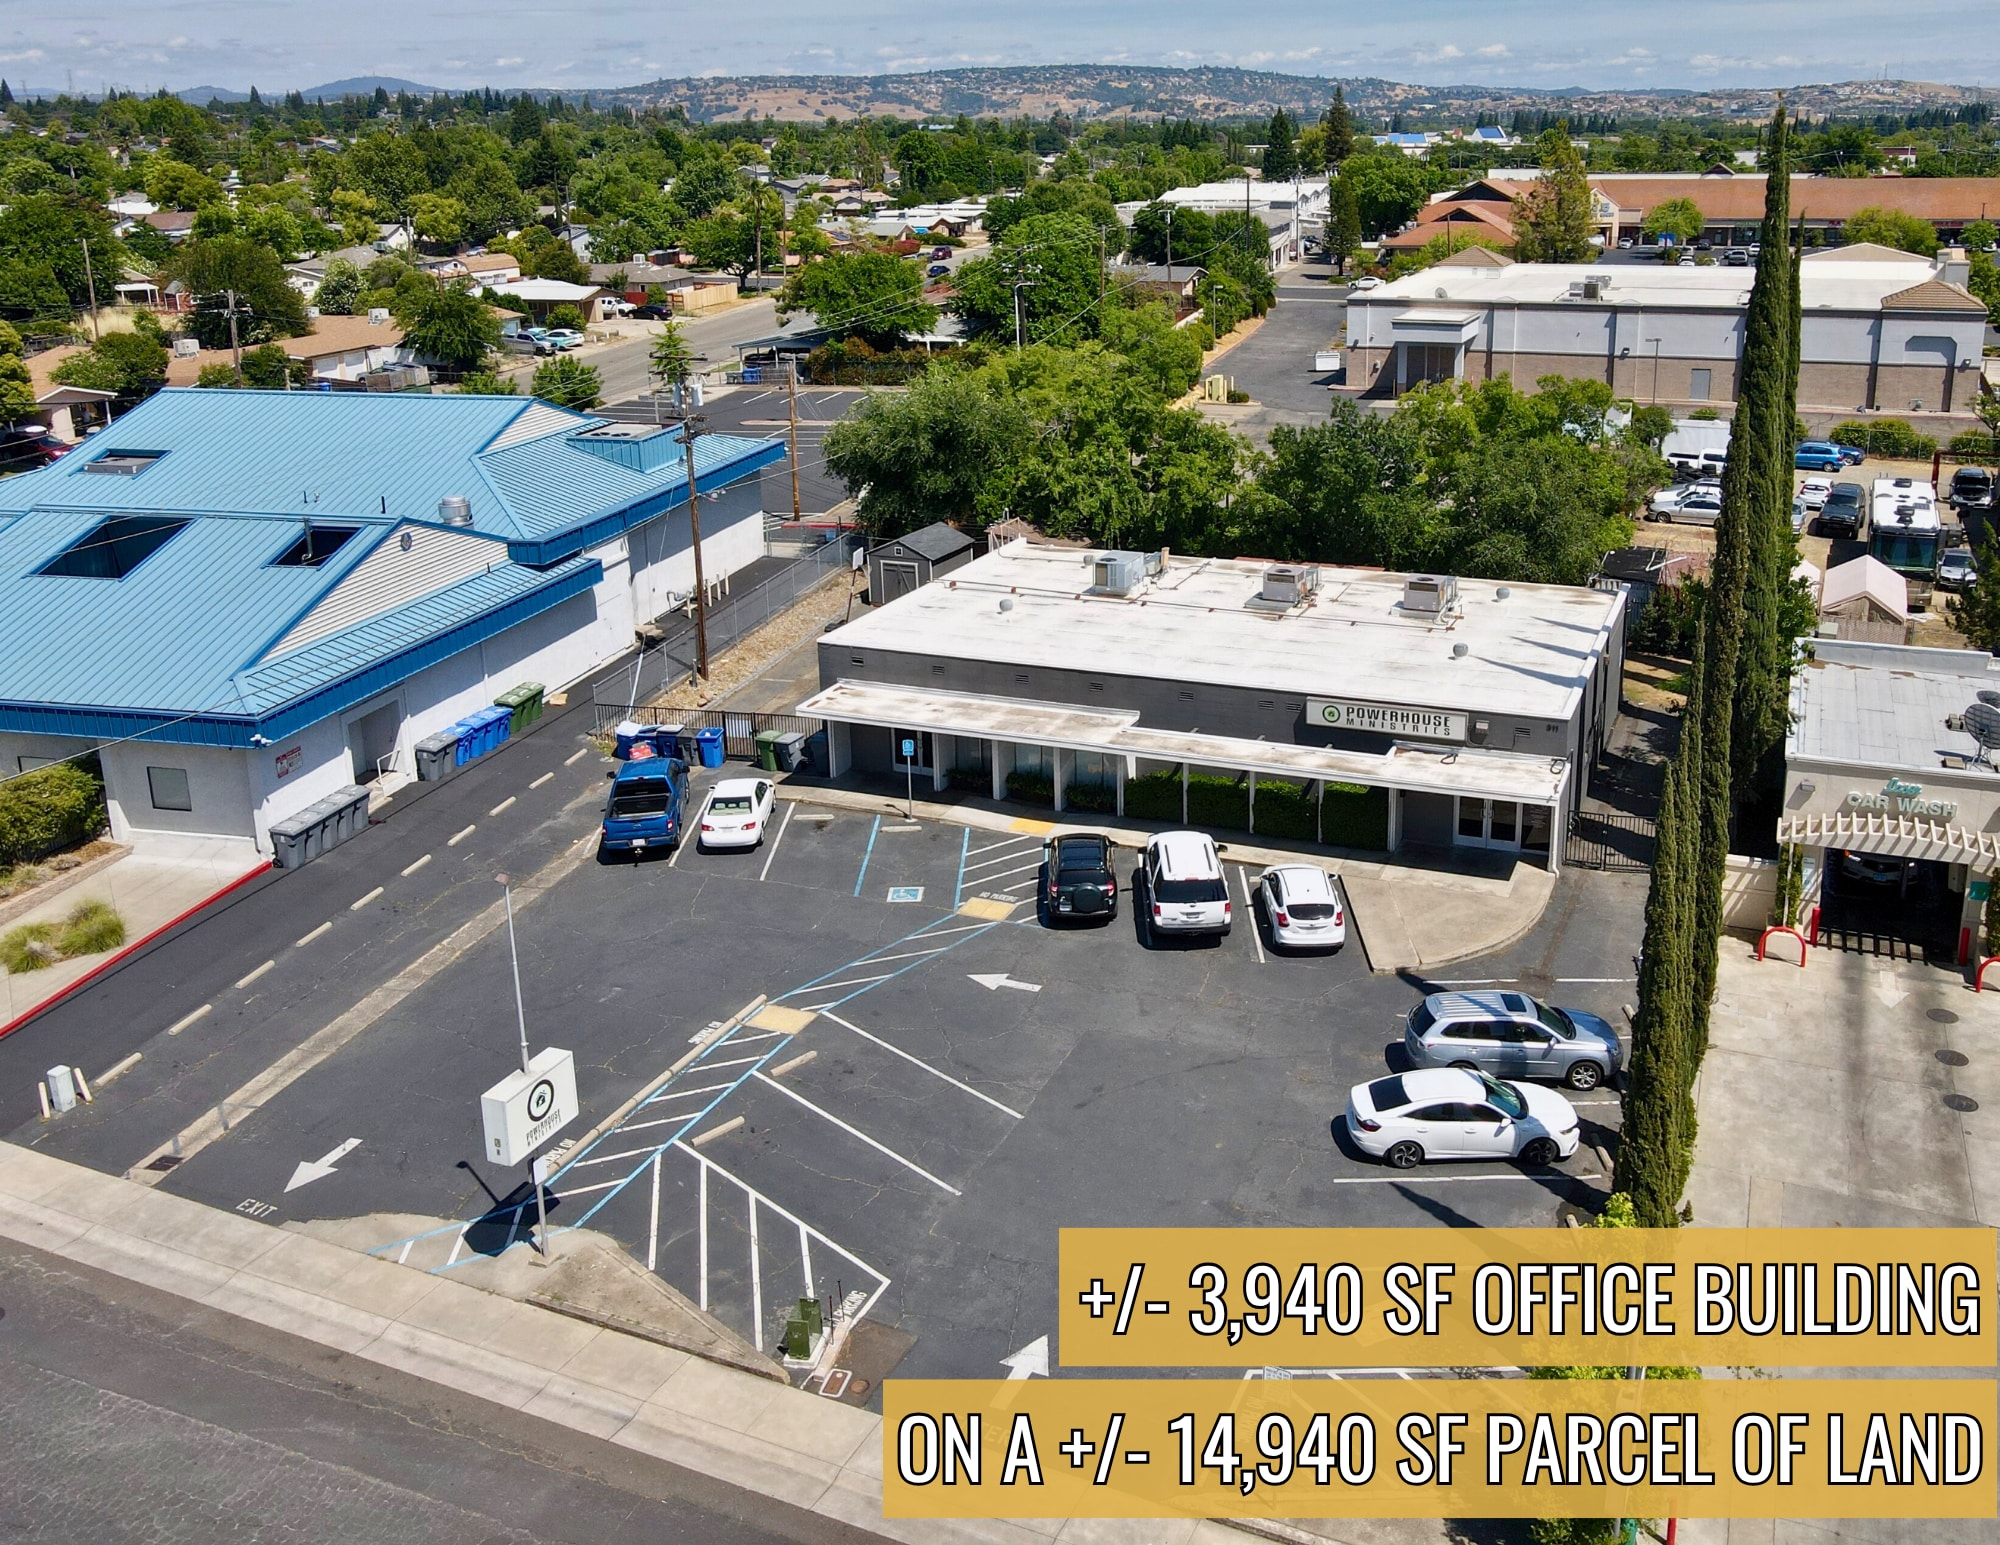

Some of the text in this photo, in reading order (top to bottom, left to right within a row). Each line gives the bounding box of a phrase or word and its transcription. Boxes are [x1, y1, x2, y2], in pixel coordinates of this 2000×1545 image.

[1346, 706, 1450, 728] POWERHOUSE
[1346, 718, 1450, 736] MINISTRIES
[1847, 791, 1958, 818] CAR WASH
[526, 1108, 561, 1141] POWERHOUSE
[235, 1198, 278, 1218] EXIT
